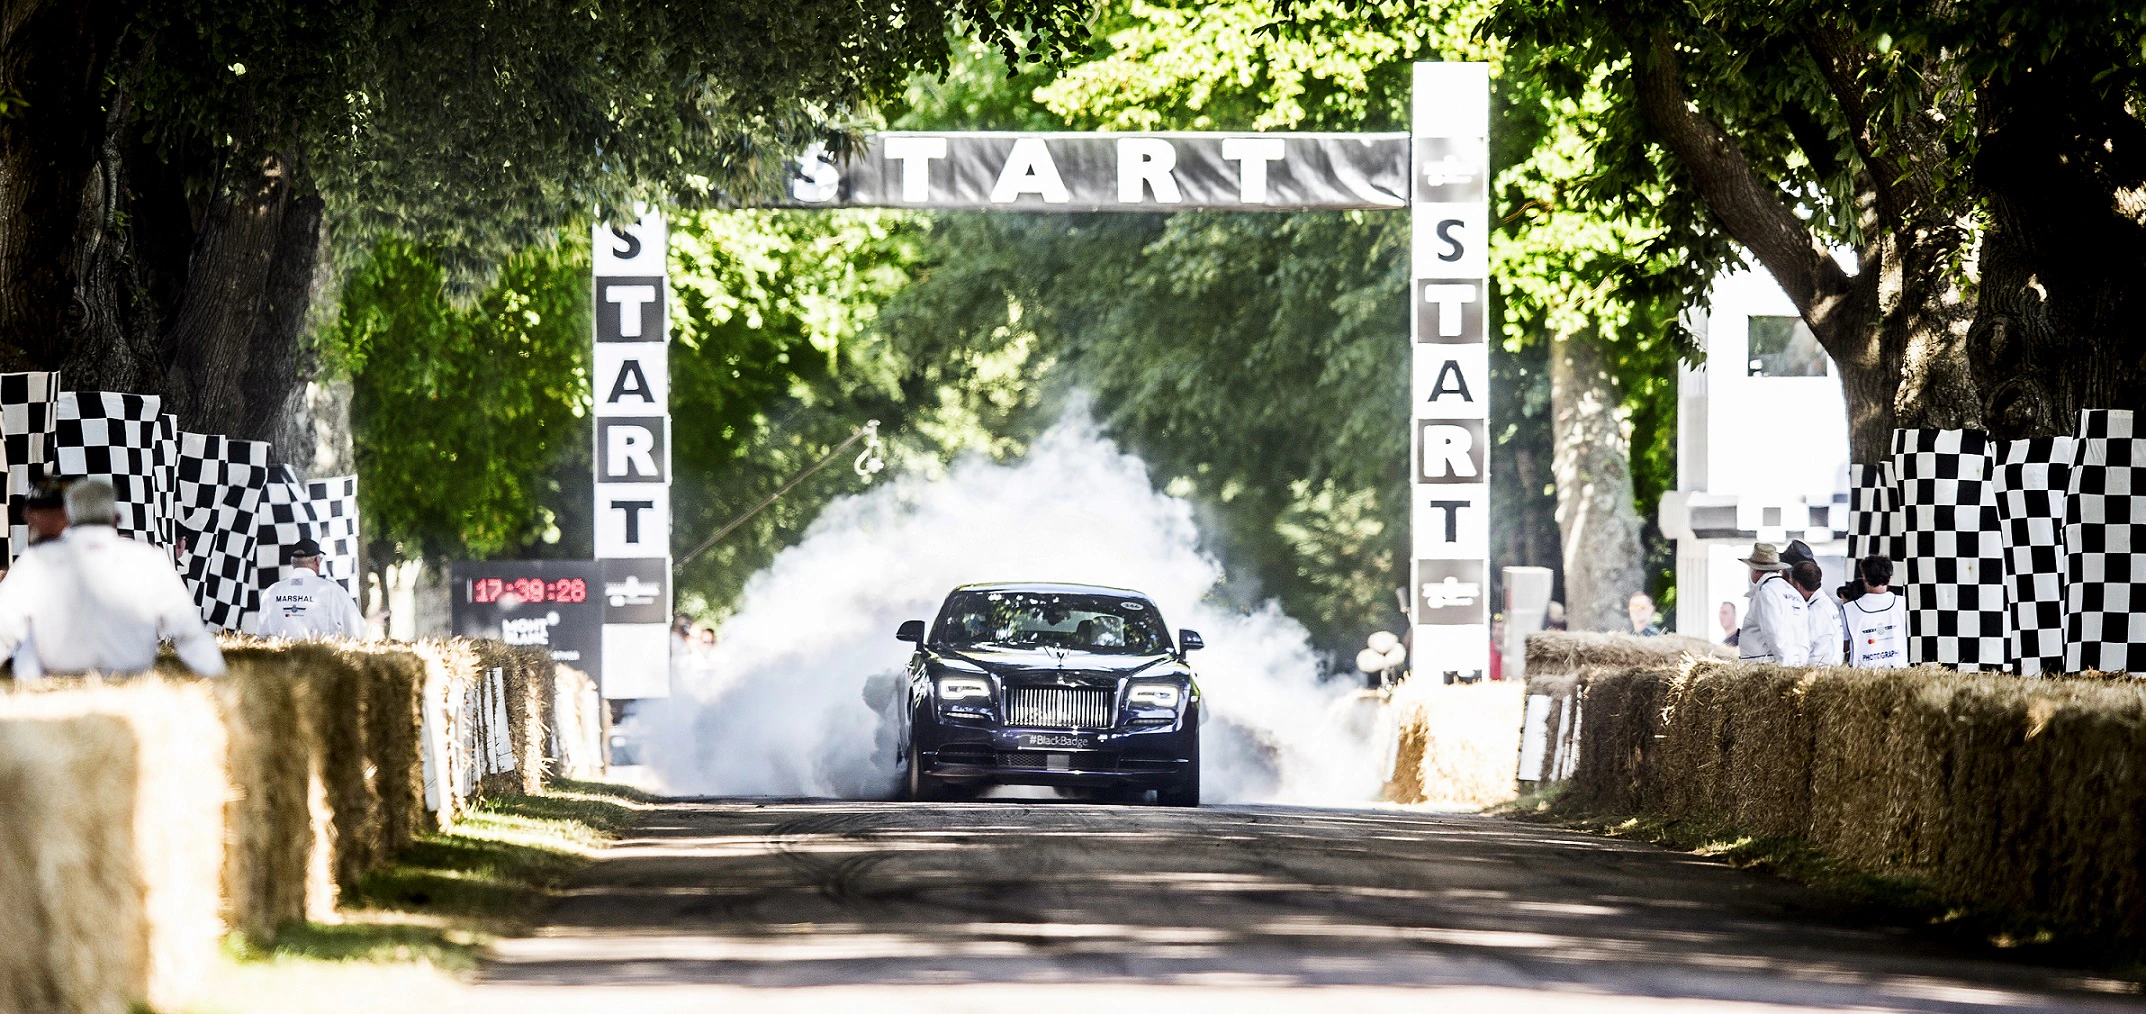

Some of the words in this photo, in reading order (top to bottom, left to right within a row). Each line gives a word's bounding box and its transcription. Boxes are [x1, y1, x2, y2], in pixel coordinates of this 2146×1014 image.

[793, 138, 1286, 203] START
[606, 219, 658, 544] START
[1422, 218, 1478, 543] START
[275, 595, 315, 603] MARSHAL
[1029, 734, 1088, 749] #BlackBadge
